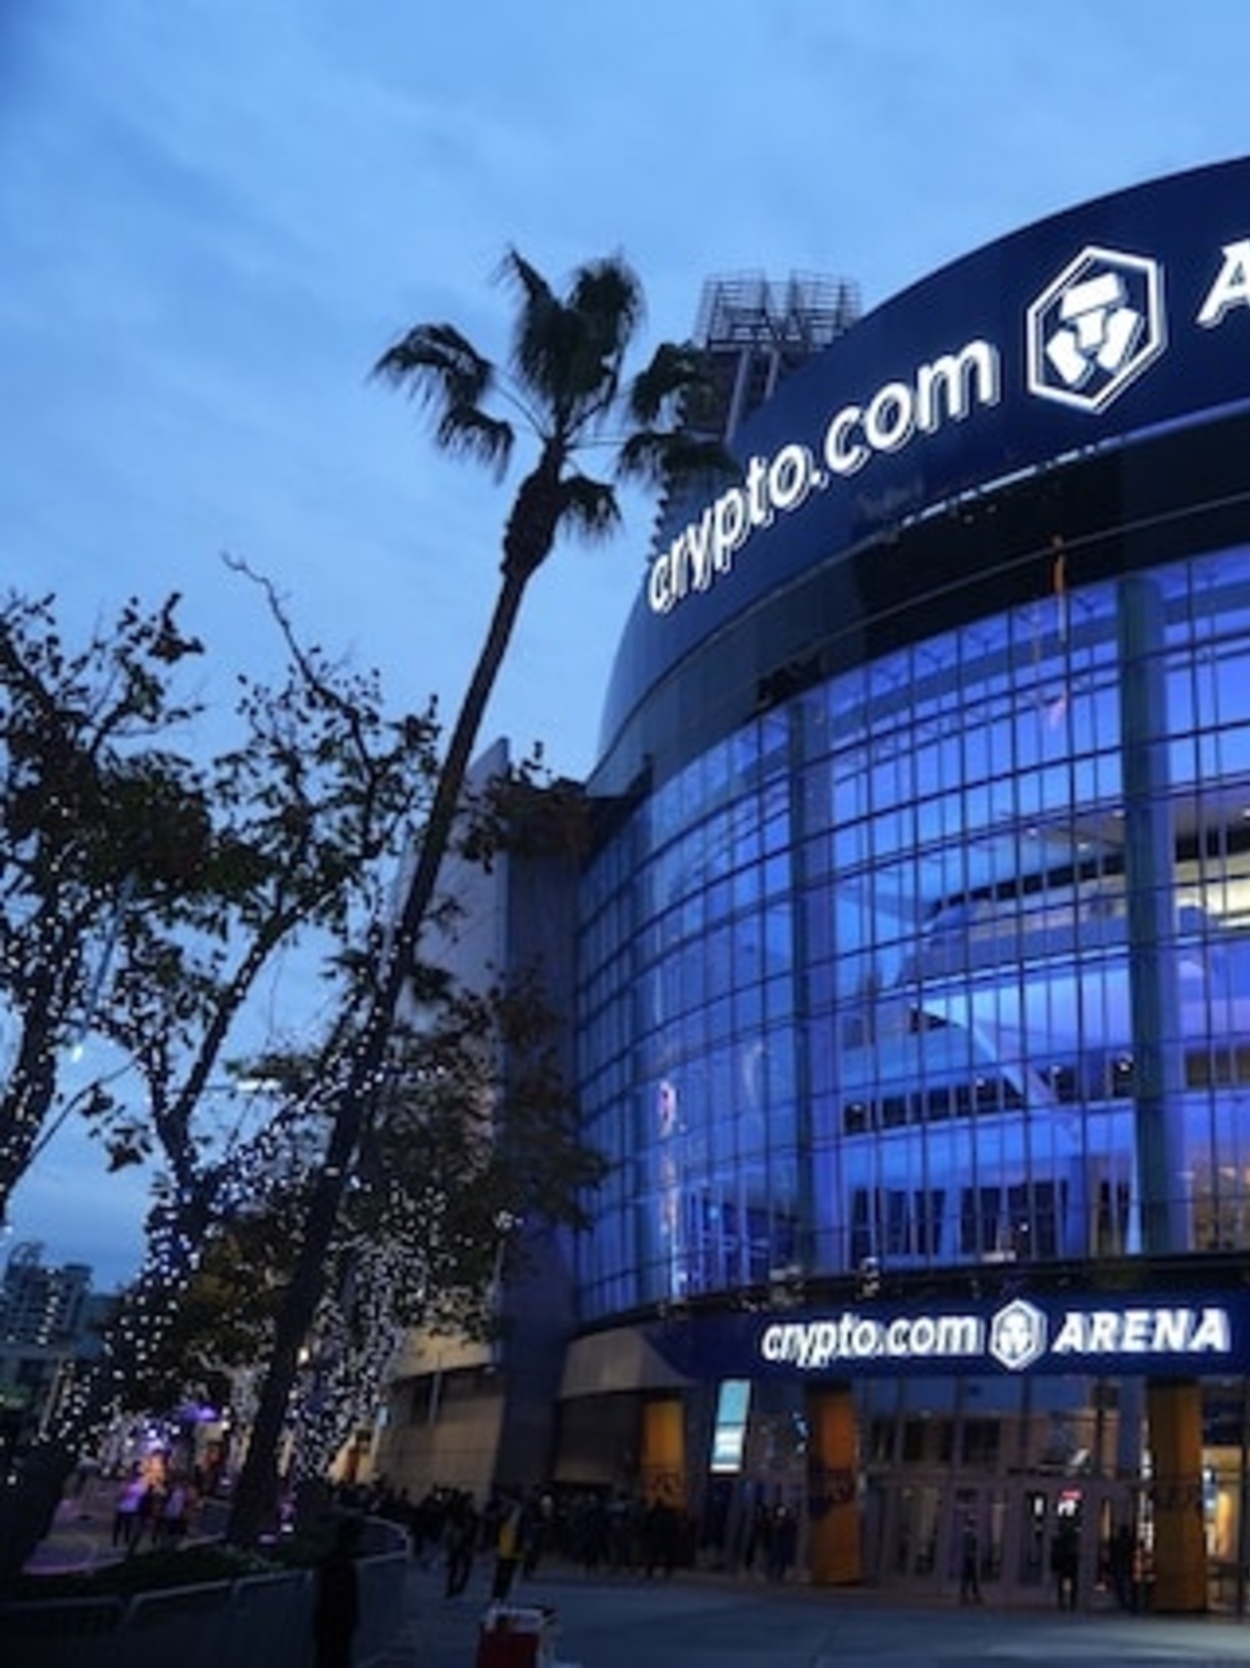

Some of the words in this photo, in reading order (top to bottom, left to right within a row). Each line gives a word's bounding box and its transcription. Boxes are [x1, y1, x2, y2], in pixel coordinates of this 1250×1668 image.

[646, 338, 999, 614] crypto.com
[761, 1311, 984, 1368] crypto.com
[1052, 1308, 1231, 1353] ARENA
